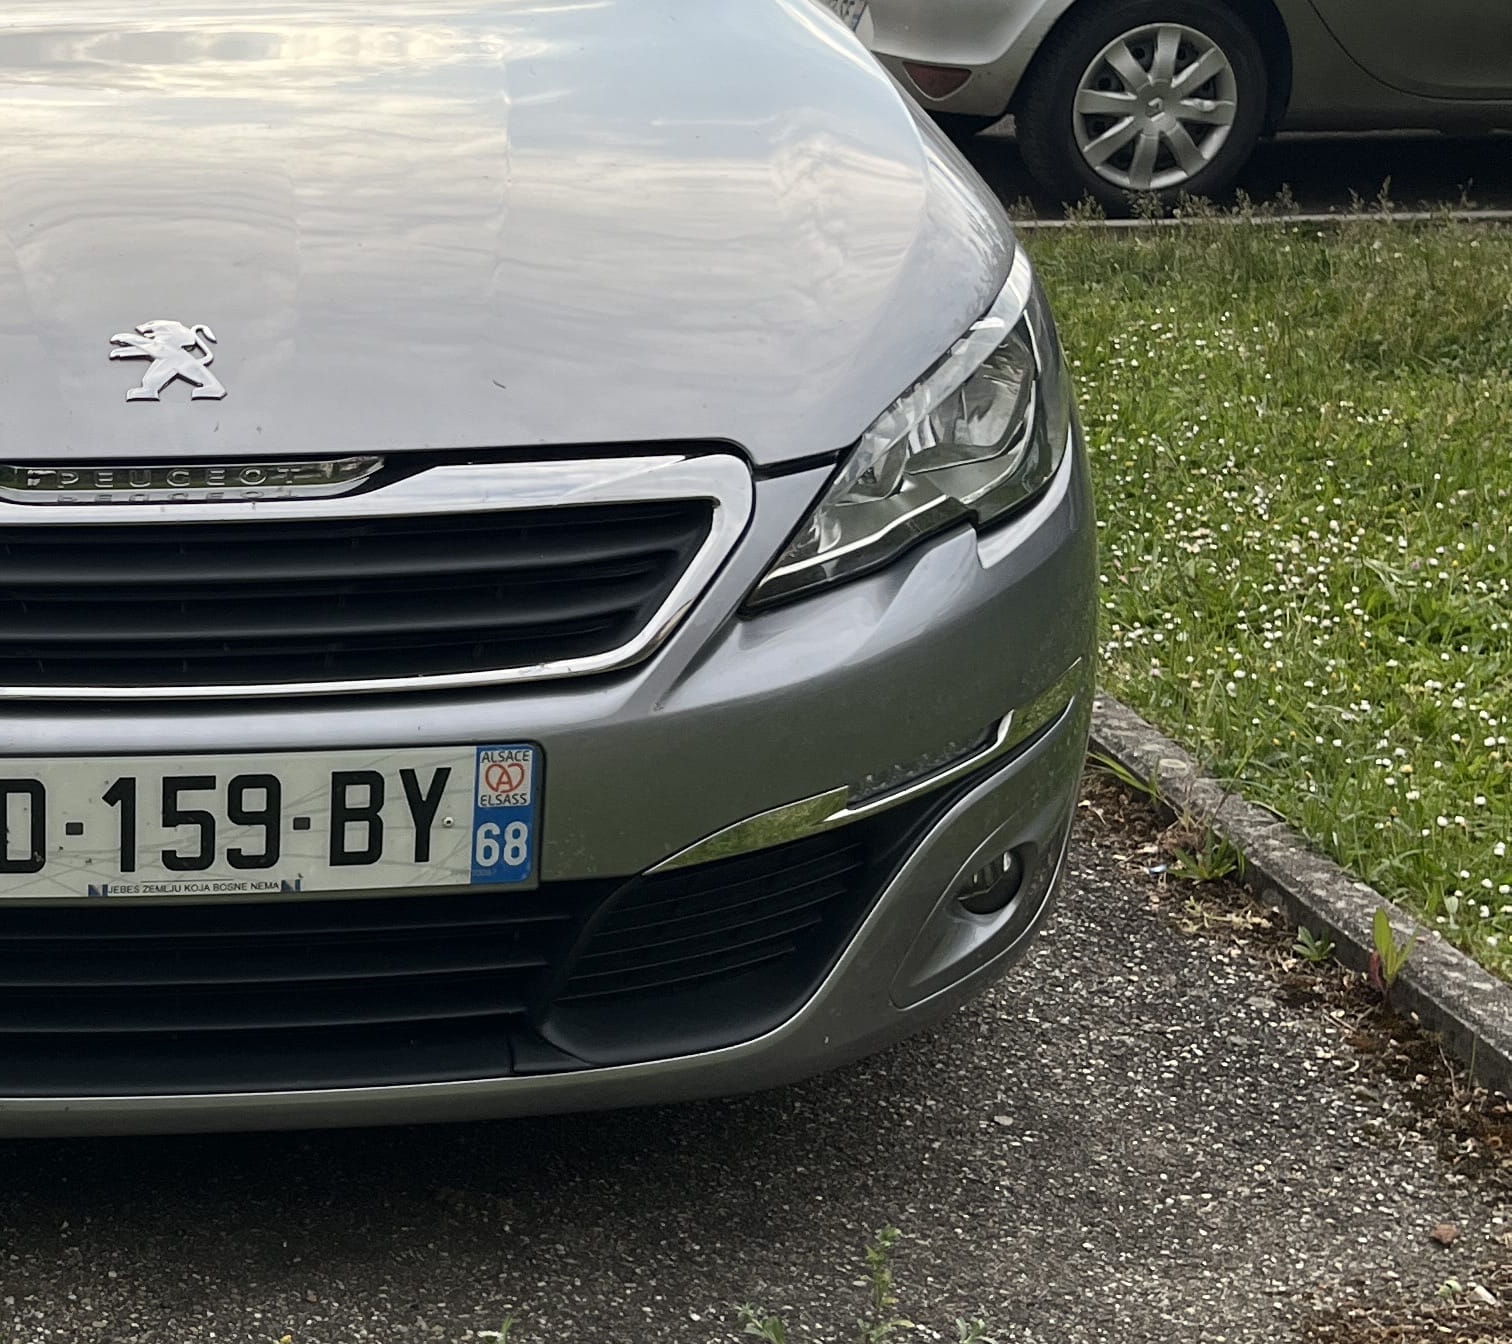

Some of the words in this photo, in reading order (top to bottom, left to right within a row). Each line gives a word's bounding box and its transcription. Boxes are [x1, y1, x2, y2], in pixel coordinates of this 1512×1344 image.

[57, 467, 303, 489] PEUGEOT
[481, 750, 530, 763] ALSACE
[480, 793, 528, 806] ELSASS
[475, 821, 528, 867] 68
[142, 883, 182, 893] ZEMLJU
[184, 883, 210, 893] KOJA
[212, 882, 248, 892] BOSNE
[250, 881, 280, 891] NEMA
